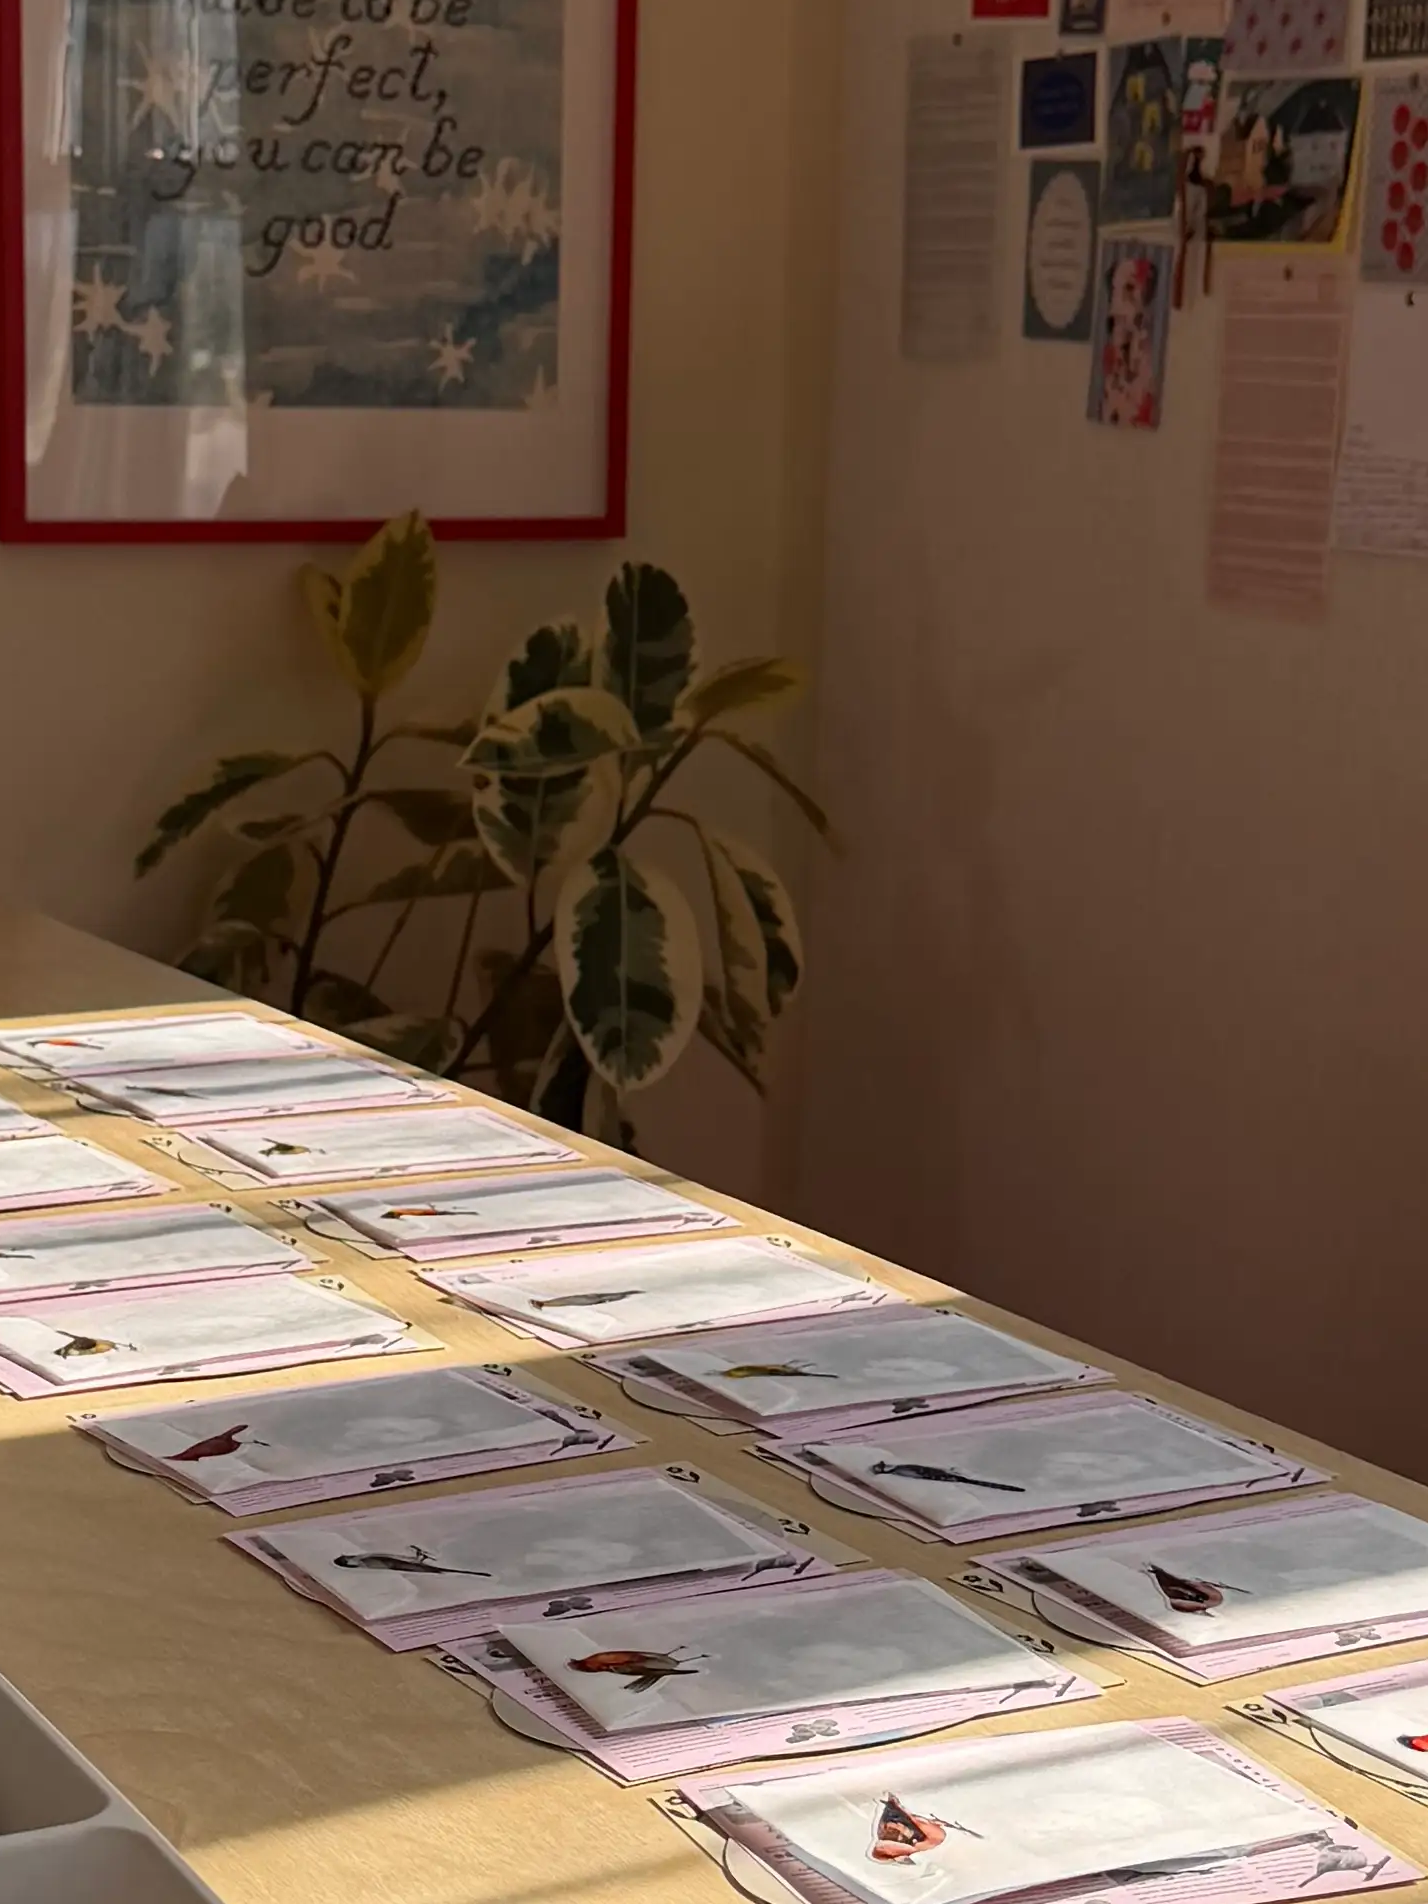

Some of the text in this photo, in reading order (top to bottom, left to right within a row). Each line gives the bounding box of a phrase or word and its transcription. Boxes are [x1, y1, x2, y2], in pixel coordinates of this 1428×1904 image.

[300, 136, 411, 177] can
[421, 116, 486, 180] be
[245, 191, 402, 278] good
